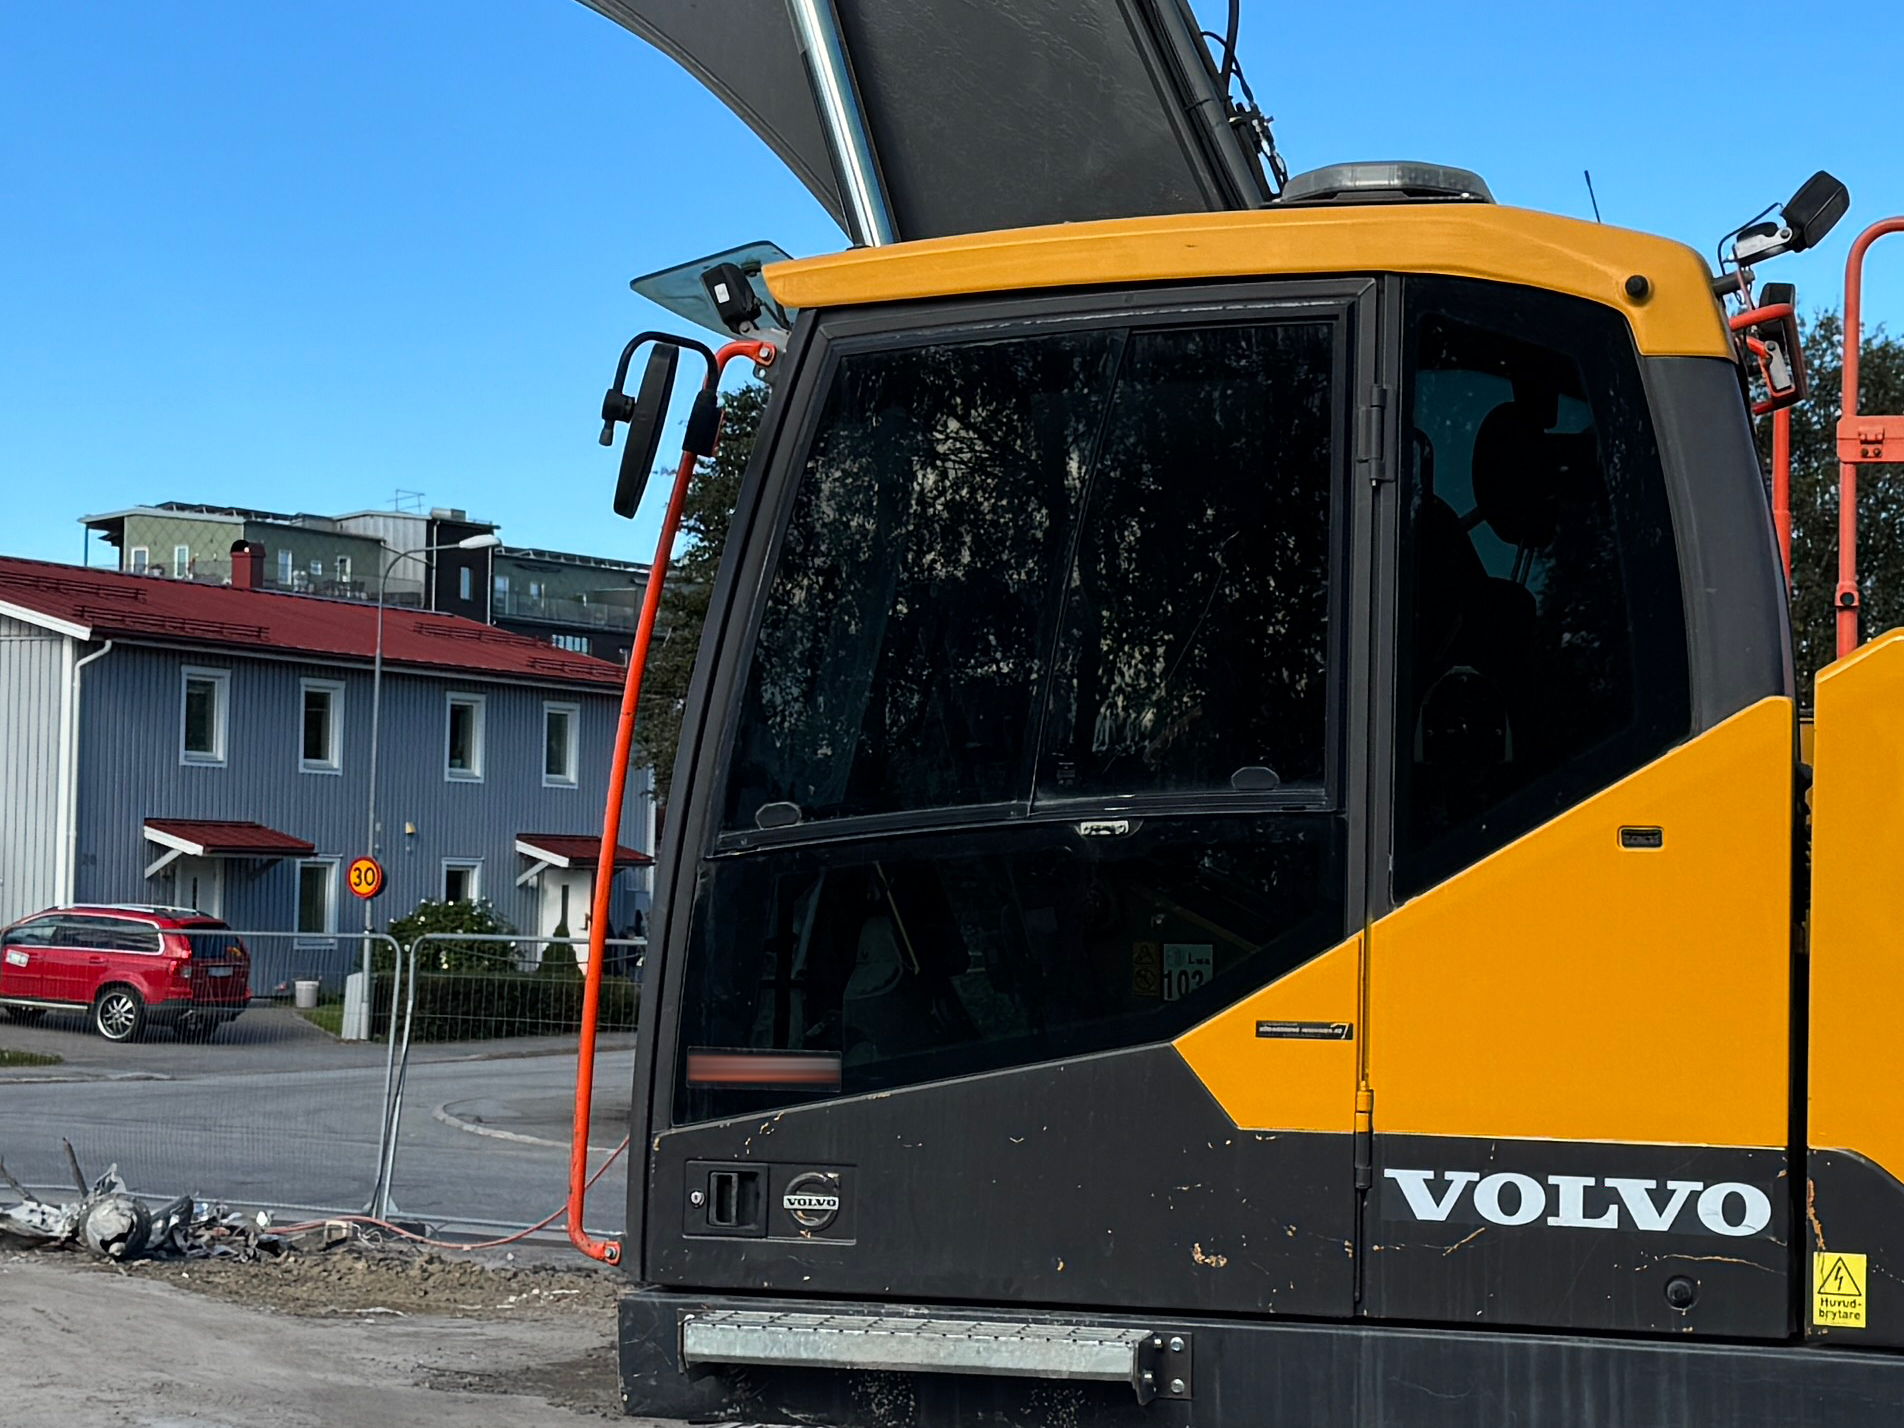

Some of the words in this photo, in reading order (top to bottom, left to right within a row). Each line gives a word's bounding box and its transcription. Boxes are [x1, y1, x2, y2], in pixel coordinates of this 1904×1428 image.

[353, 867, 375, 887] 30
[786, 1198, 836, 1207] VOLVO
[1384, 1169, 1772, 1237] VOLVO
[1819, 1308, 1861, 1320] brytare
